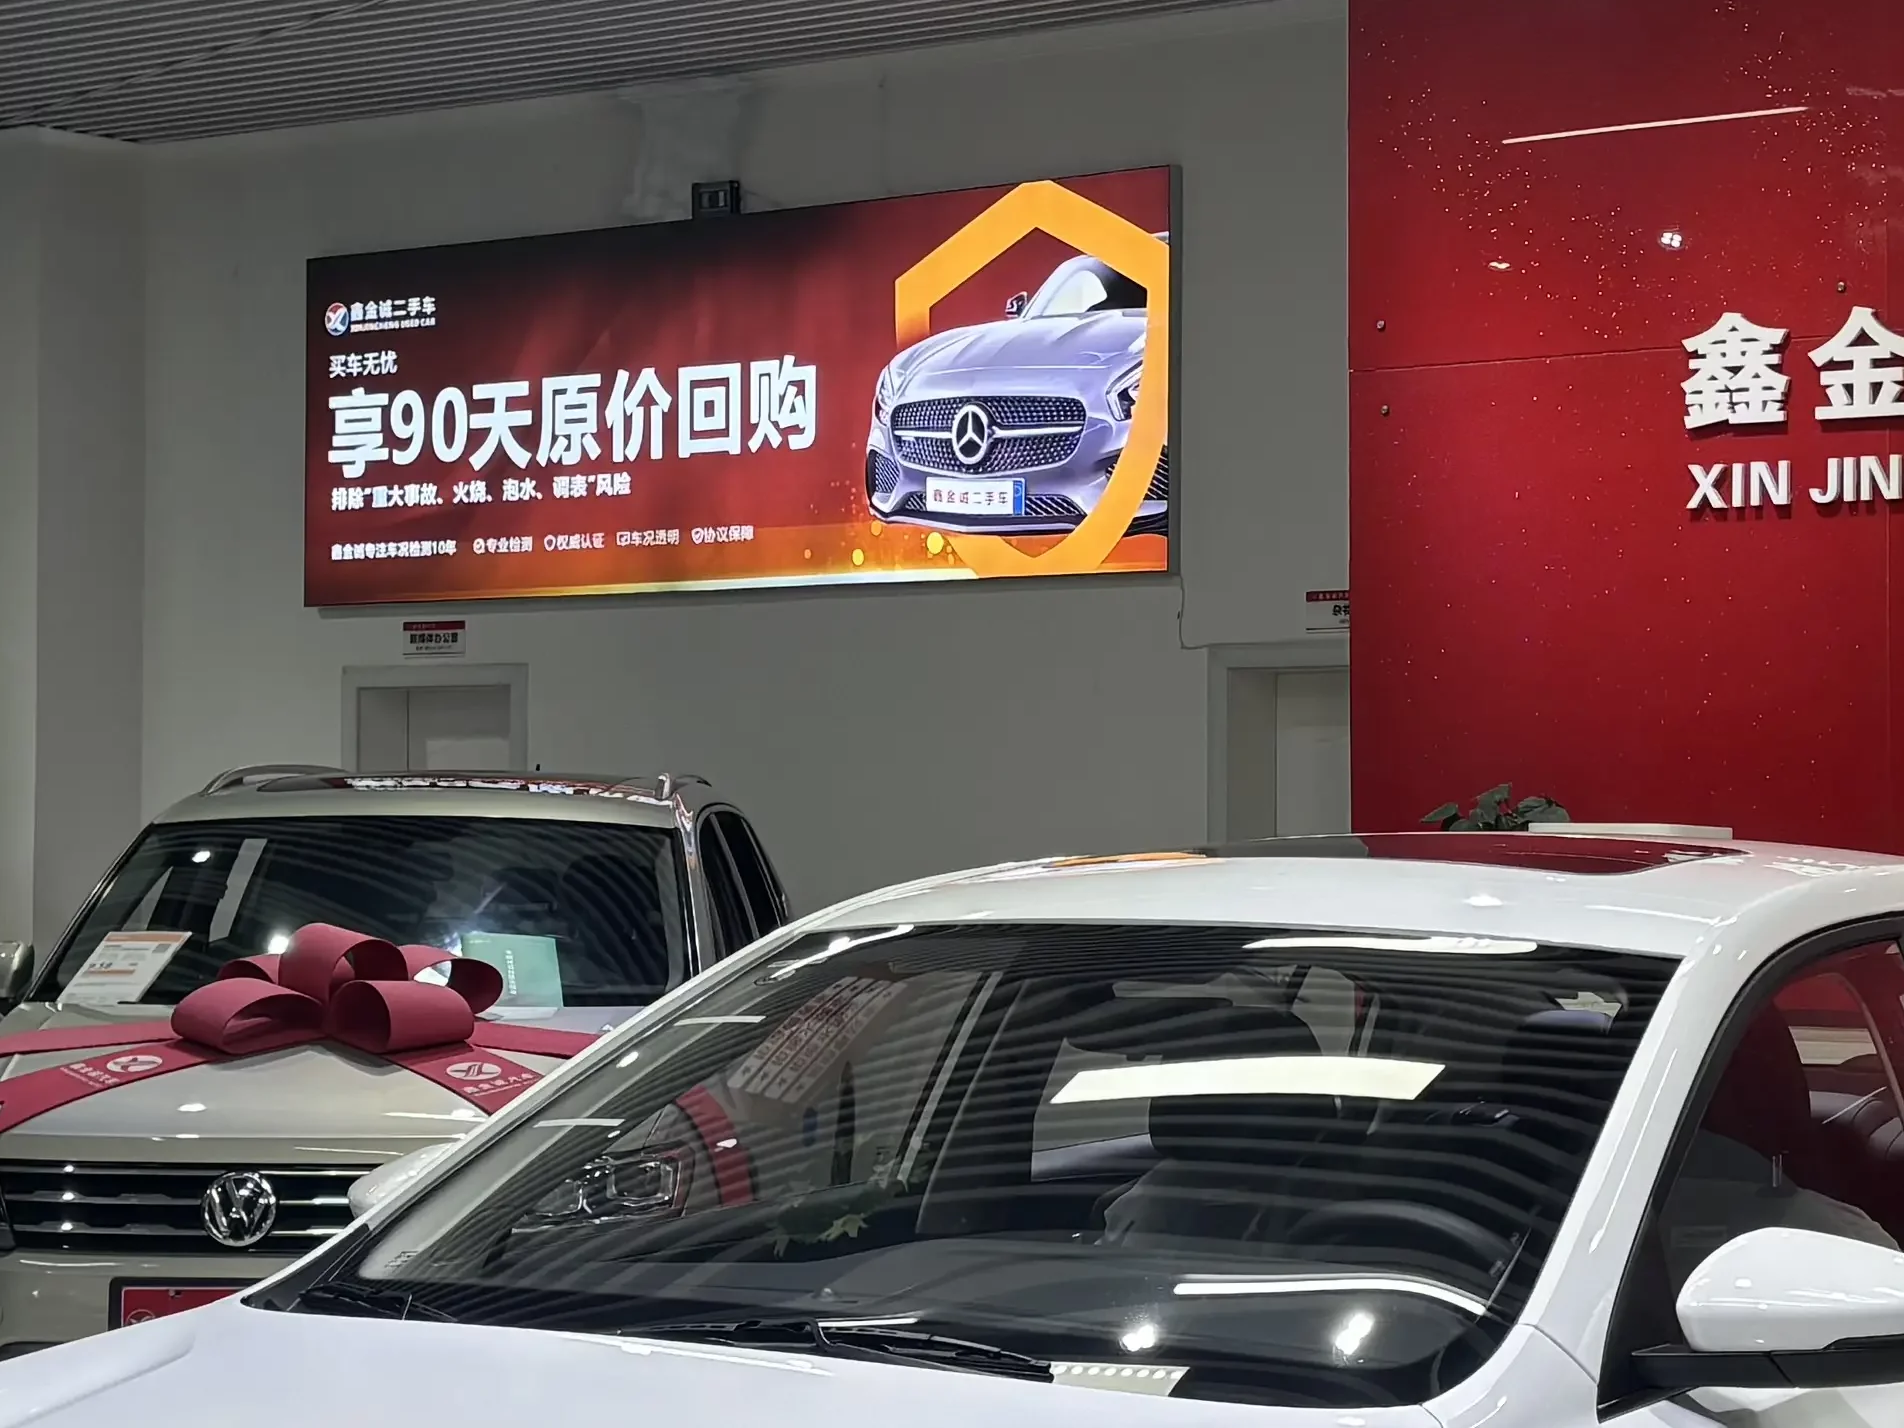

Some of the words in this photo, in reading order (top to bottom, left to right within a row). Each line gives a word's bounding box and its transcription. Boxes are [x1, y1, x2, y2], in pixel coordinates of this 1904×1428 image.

[328, 350, 398, 379] 买车无忧
[328, 354, 817, 479] 享90天原价回购
[1686, 457, 1792, 511] XIN
